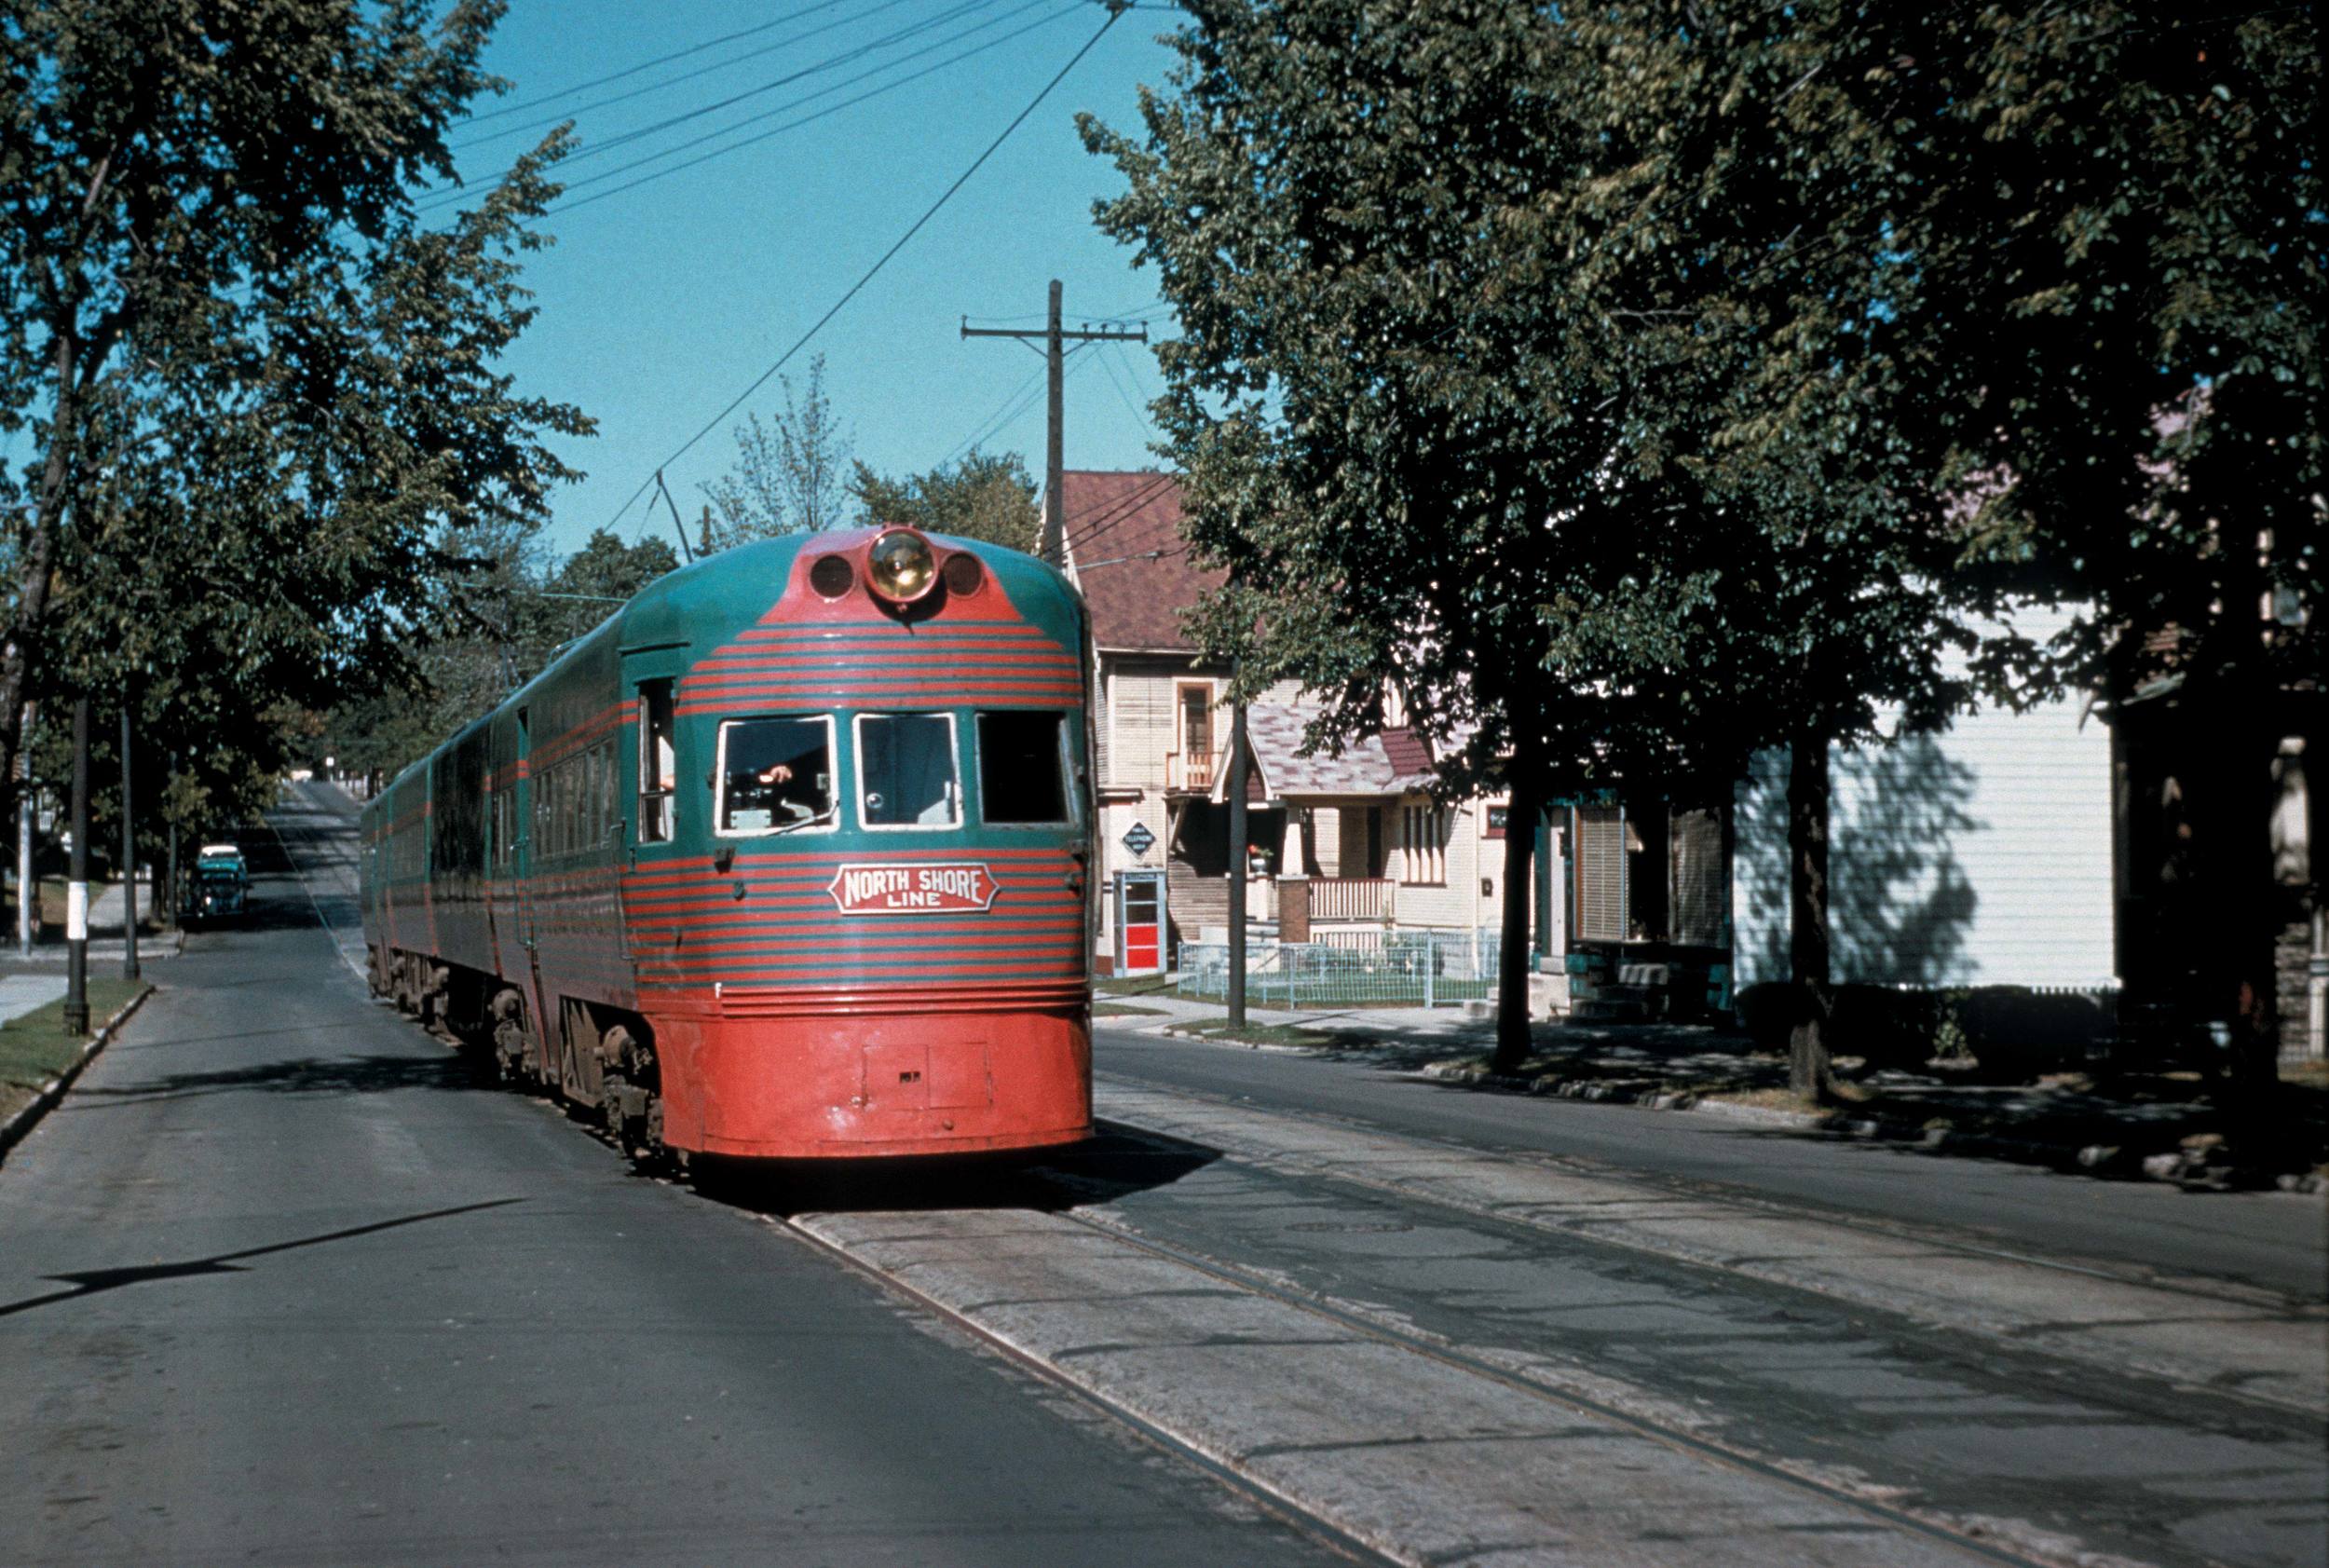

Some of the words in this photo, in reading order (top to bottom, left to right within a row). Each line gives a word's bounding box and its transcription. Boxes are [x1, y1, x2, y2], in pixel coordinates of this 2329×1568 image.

[844, 870, 909, 907] NORTH
[919, 869, 985, 905] SHORE
[887, 892, 941, 907] LINE
